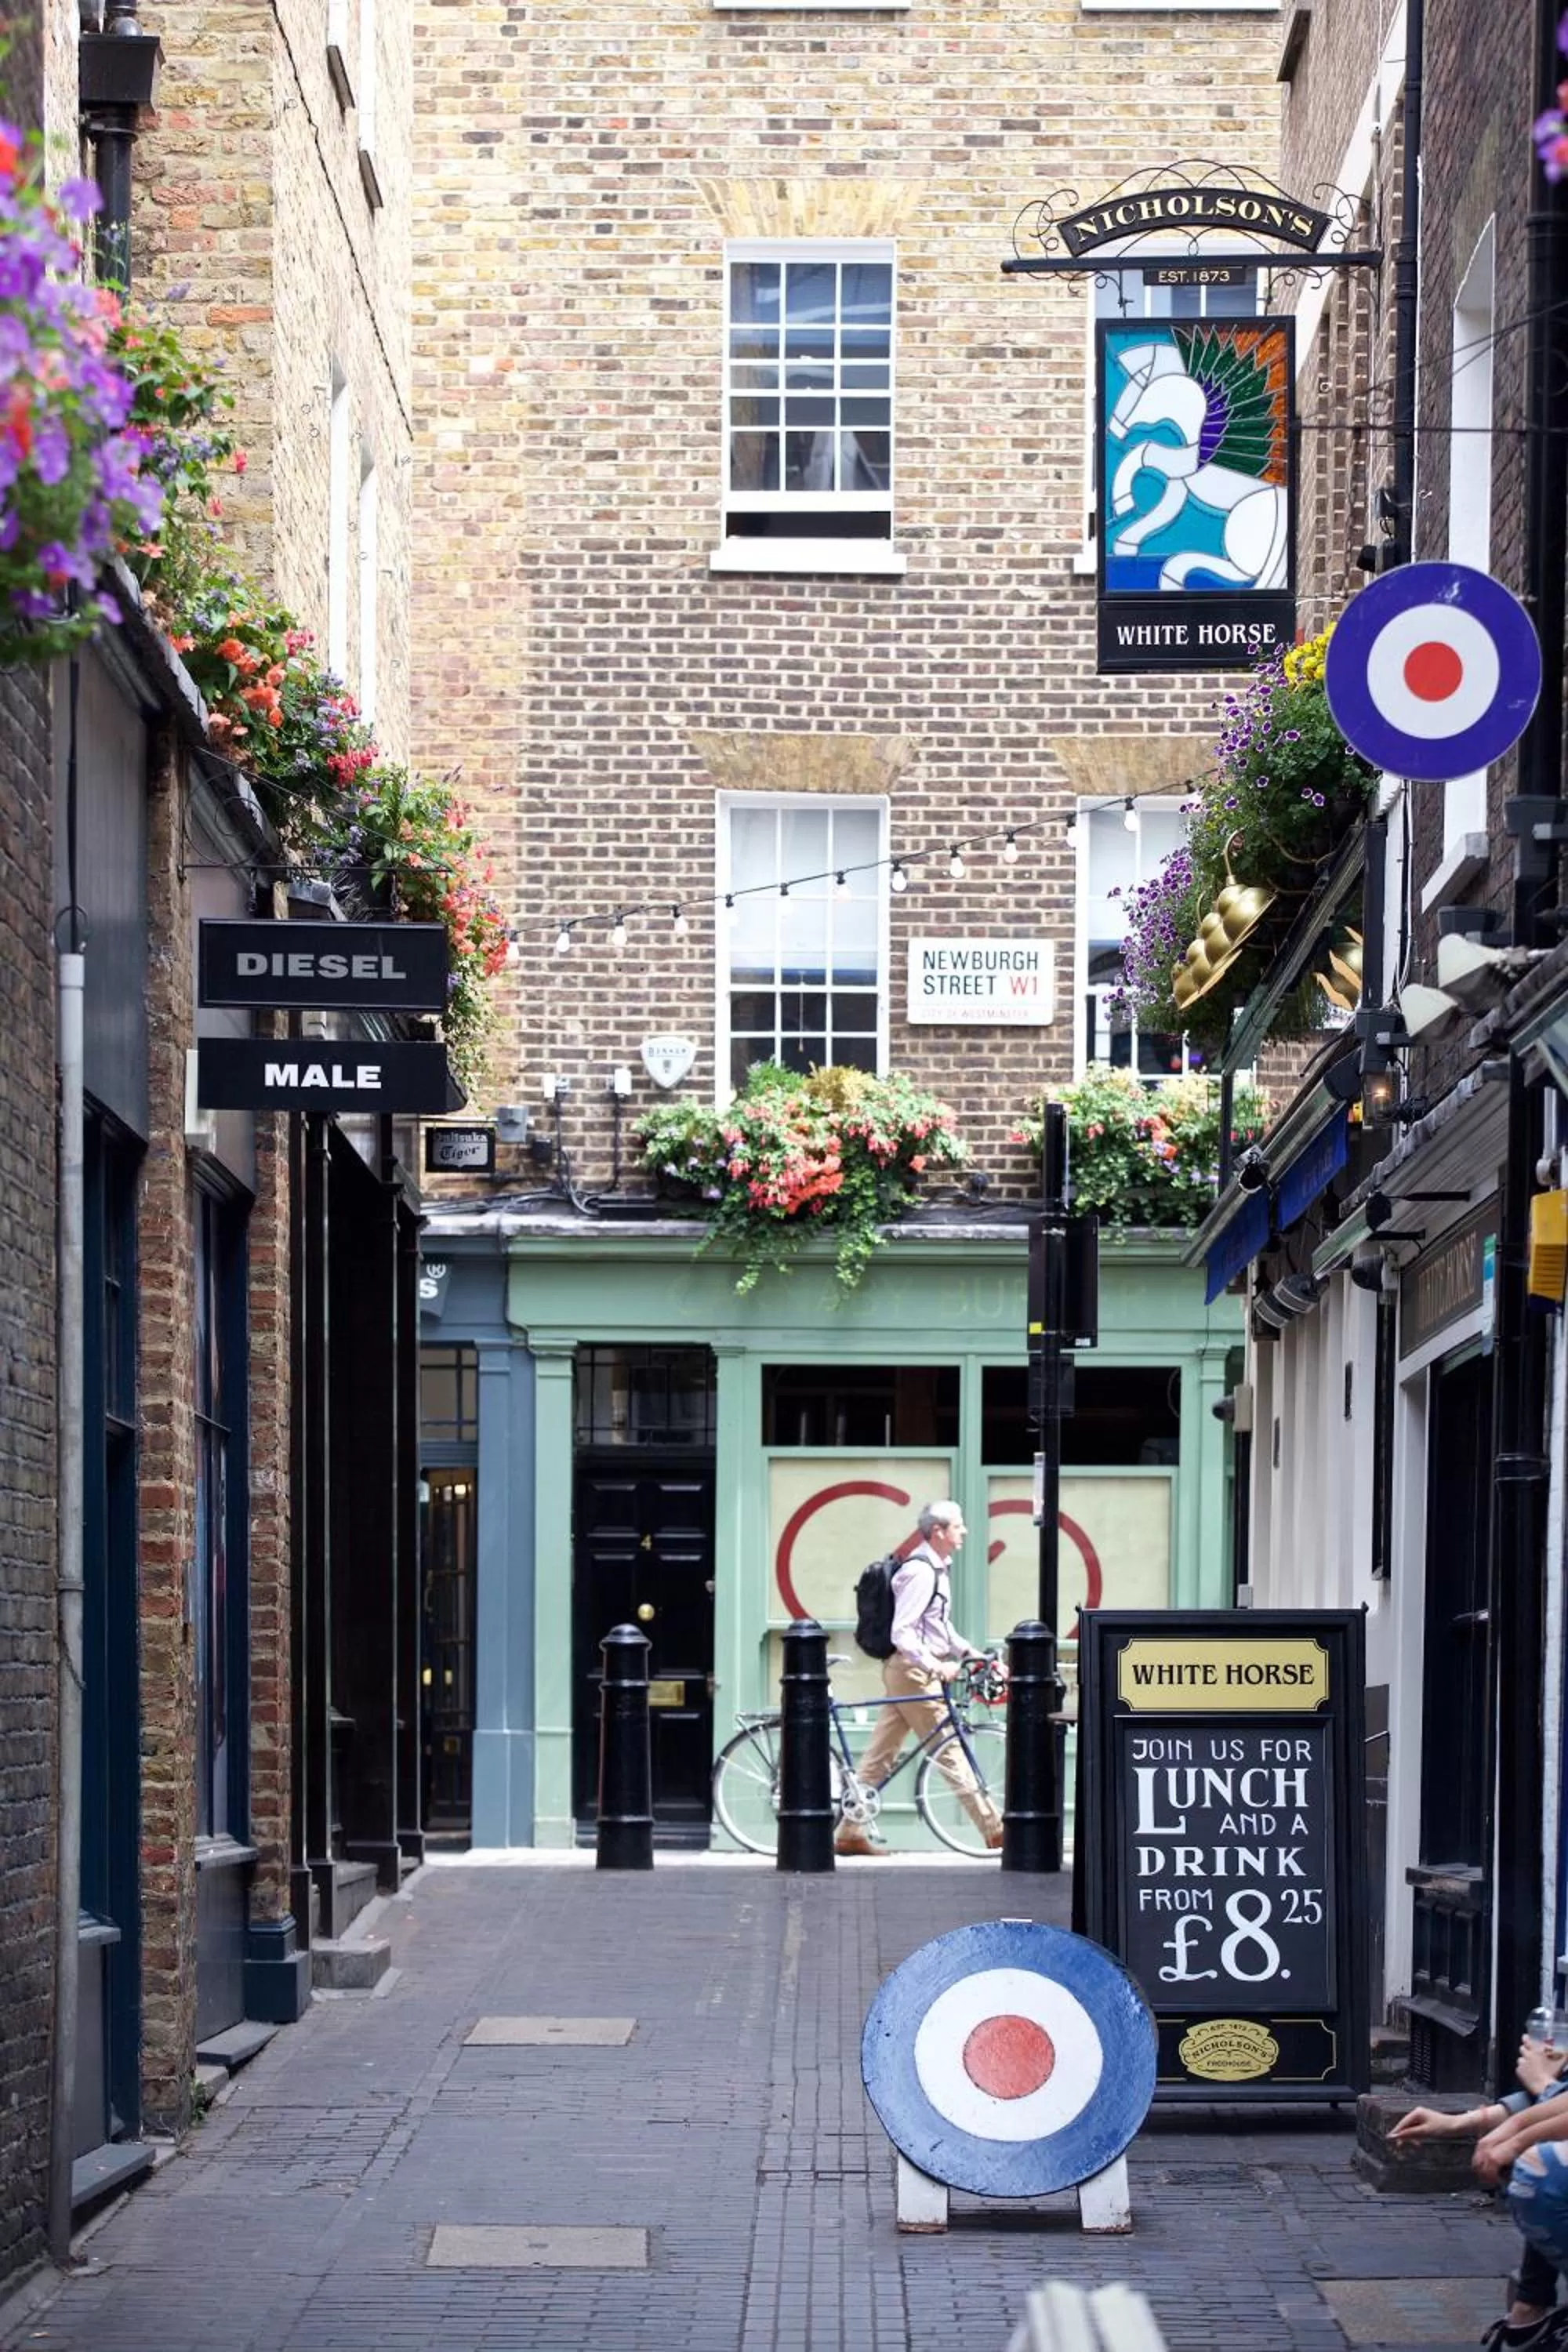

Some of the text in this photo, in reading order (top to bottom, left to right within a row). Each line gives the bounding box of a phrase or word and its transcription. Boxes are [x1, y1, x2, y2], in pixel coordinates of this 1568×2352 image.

[1073, 194, 1315, 243] NICHOLSON'S
[1158, 270, 1231, 283] EST. 1873
[1116, 624, 1276, 645] WHITE HORSE
[237, 952, 407, 979] DIESEL
[922, 950, 1039, 971] NEWBURGH
[923, 975, 1038, 996] STREET W1
[264, 1062, 383, 1089] MALE
[641, 1534, 652, 1551] 4
[1132, 1664, 1315, 1685] WHITE HORSE
[1131, 1738, 1312, 1762] JOIN US FOR
[1132, 1766, 1310, 1835] LUNCH
[1219, 1813, 1309, 1835] AND A
[1134, 1846, 1308, 1877] DRINK
[1139, 1888, 1214, 1911] FROM
[1192, 2040, 1268, 2058] NICHOLSON'S
